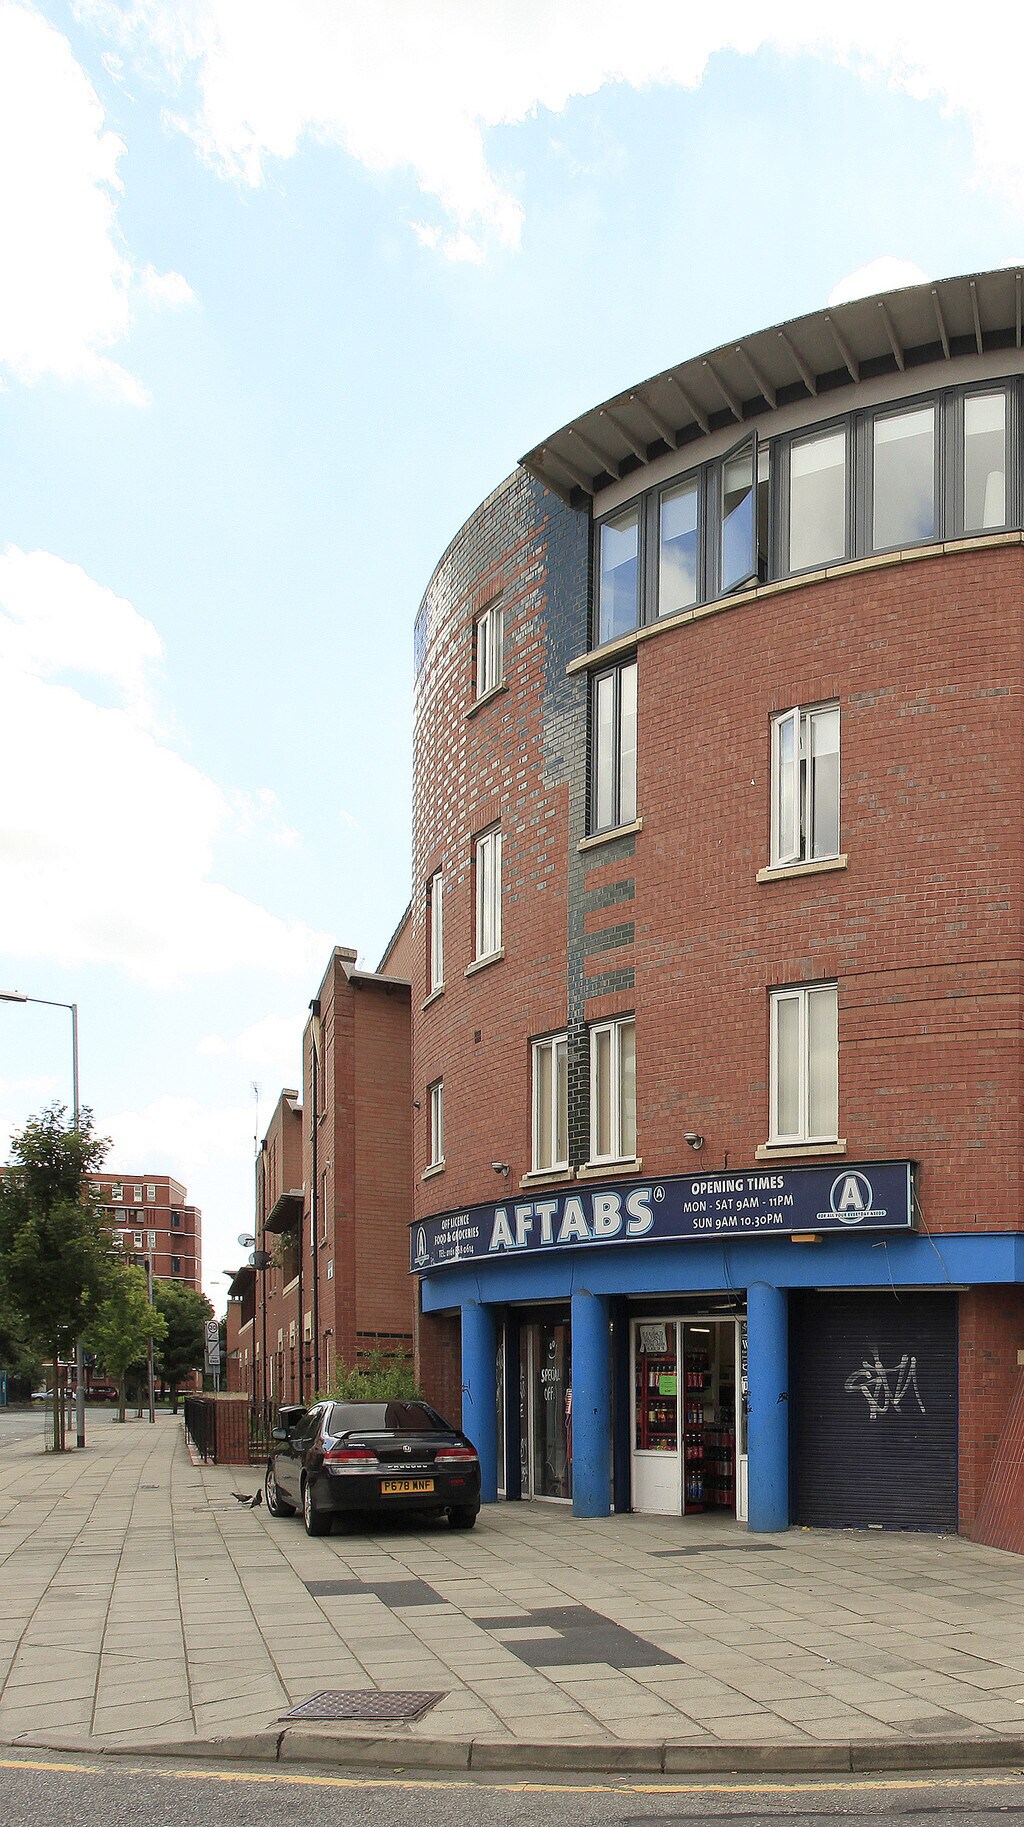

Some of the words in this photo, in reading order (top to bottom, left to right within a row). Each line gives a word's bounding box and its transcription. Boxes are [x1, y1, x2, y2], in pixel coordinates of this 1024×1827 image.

[691, 1179, 744, 1195] OPENING
[747, 1176, 784, 1191] TIMES
[683, 1201, 707, 1213] MON
[715, 1199, 733, 1211] SAT
[736, 1197, 760, 1211] 9AM
[769, 1194, 794, 1207] 11PM
[441, 1219, 451, 1231] OFF
[450, 1214, 470, 1229] LICENCE
[489, 1188, 654, 1251] AFTABS
[693, 1217, 713, 1229] SUN
[715, 1215, 738, 1229] 9AM
[740, 1212, 783, 1228] 10.30PM
[384, 1481, 410, 1491] P678
